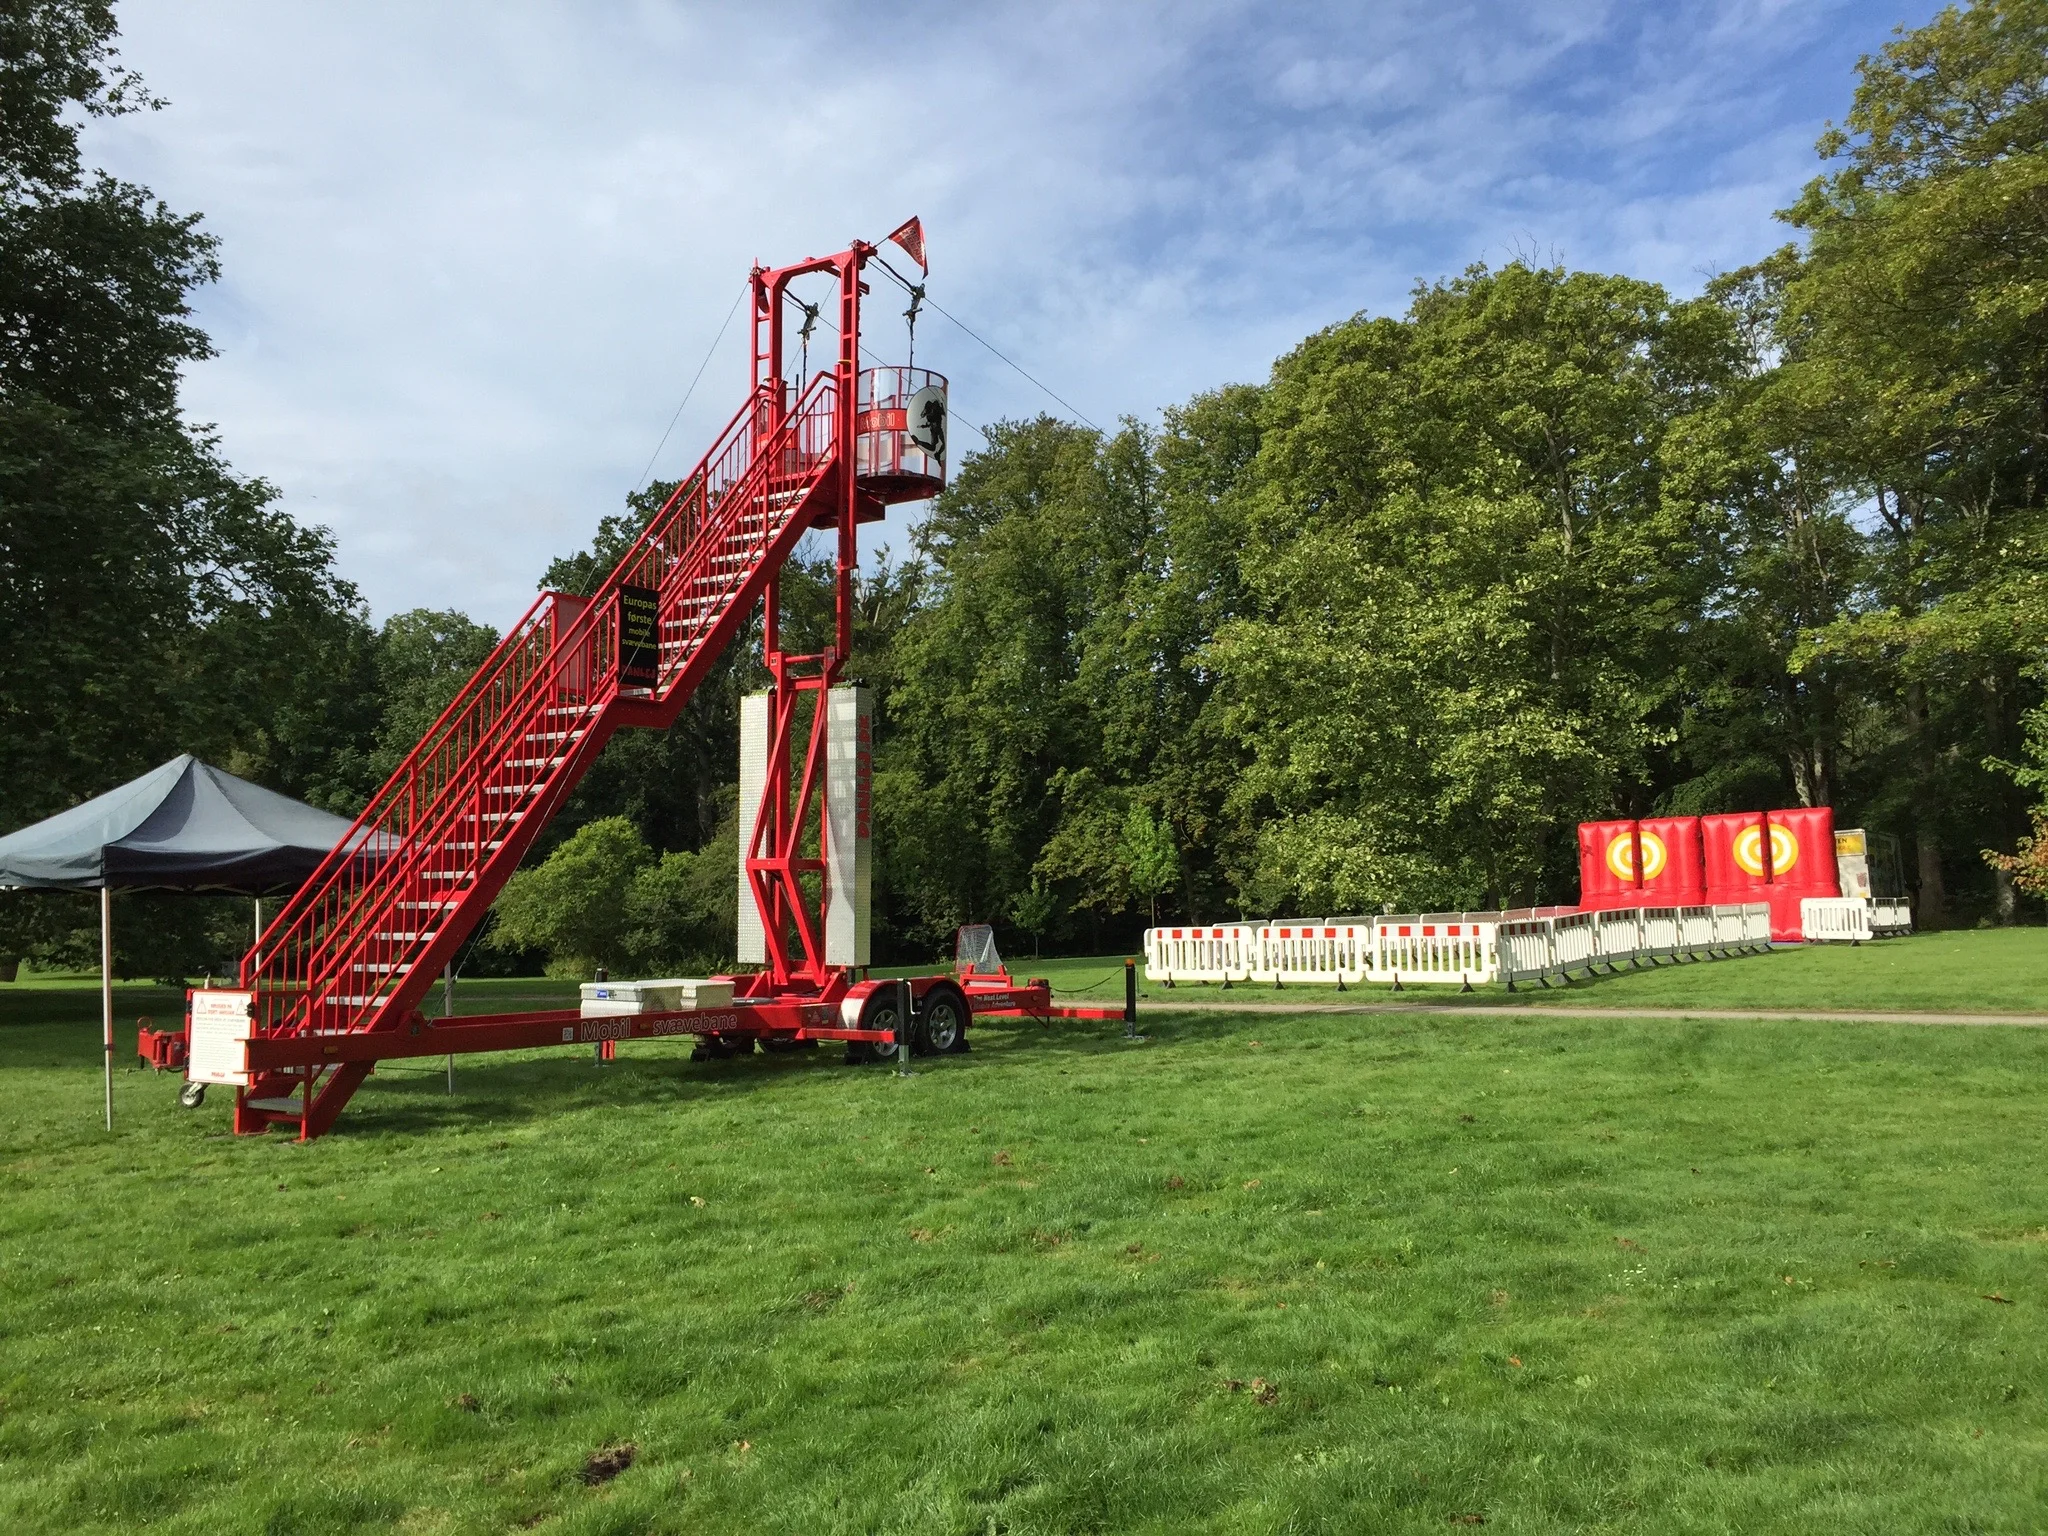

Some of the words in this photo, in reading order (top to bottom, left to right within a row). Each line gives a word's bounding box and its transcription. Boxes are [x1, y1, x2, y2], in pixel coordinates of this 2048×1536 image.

[623, 595, 657, 610] Europas
[628, 611, 652, 625] første
[983, 994, 995, 1002] Next
[996, 993, 1009, 1001] Level
[580, 1017, 631, 1041] Mobil
[653, 1012, 738, 1035] svævebane
